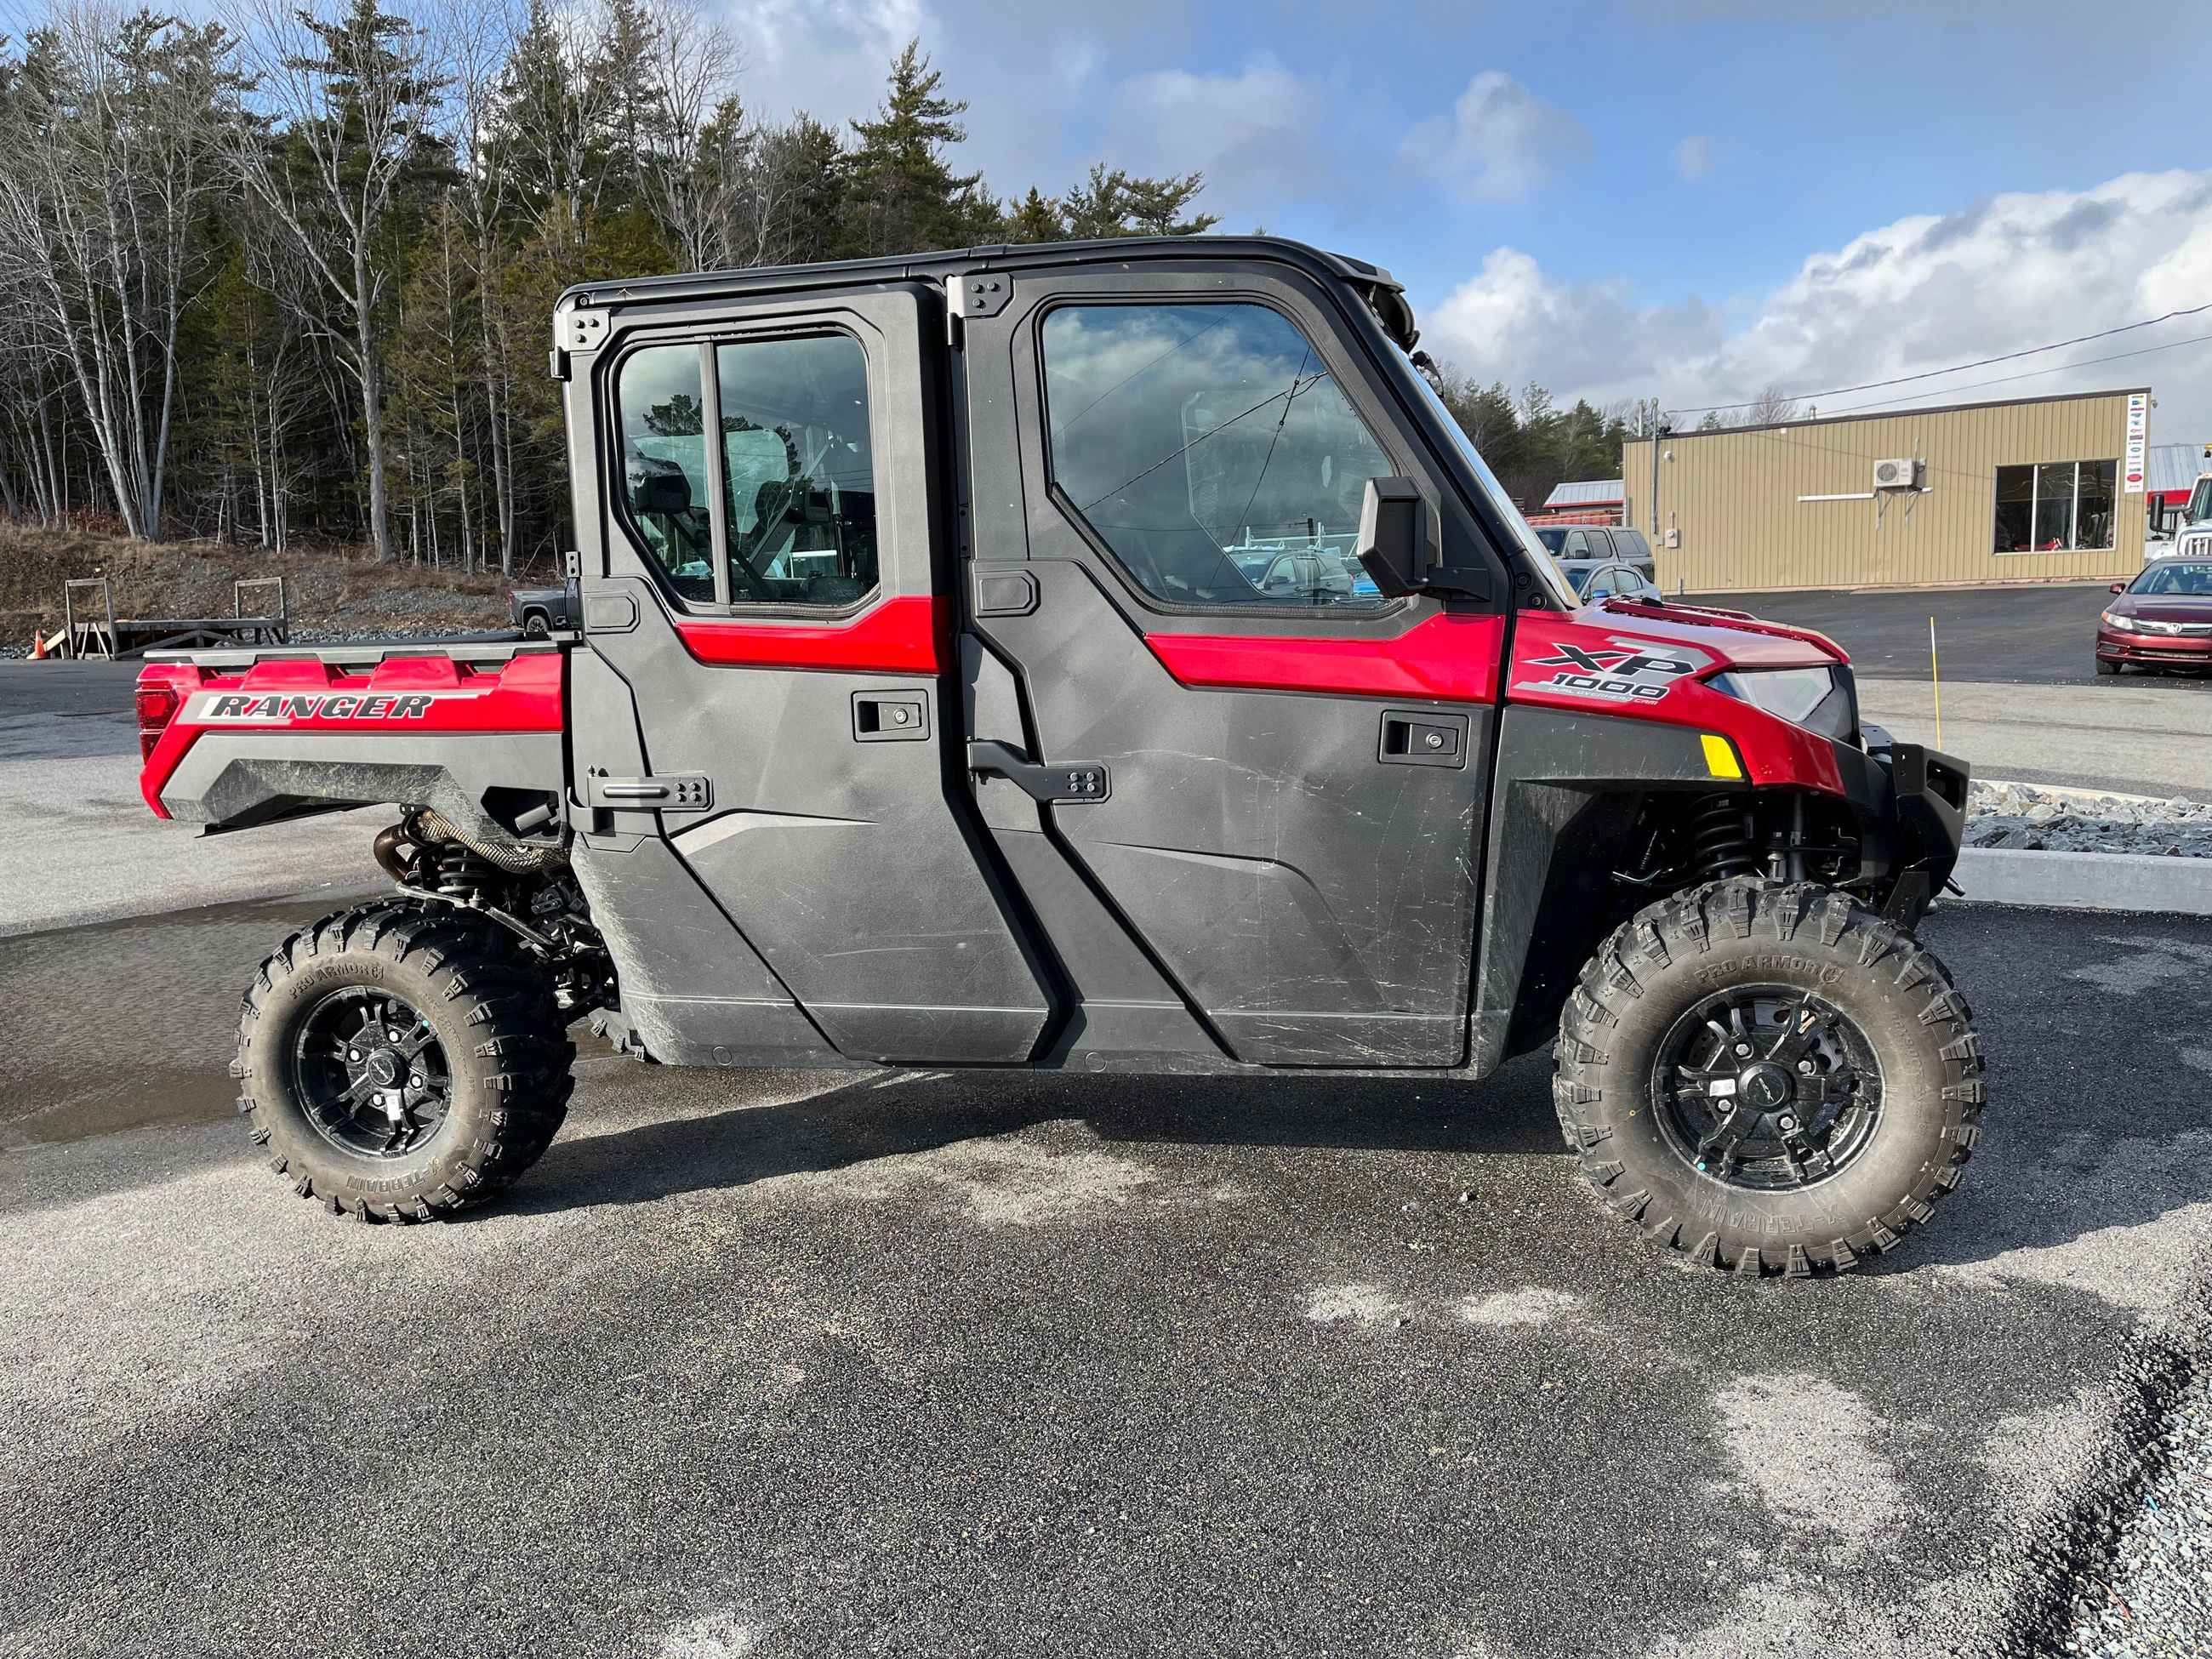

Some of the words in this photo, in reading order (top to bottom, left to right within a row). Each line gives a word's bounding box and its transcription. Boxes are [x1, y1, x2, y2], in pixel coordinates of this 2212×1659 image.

[1521, 642, 1697, 676] XP
[1552, 671, 1670, 699] 1000
[210, 693, 433, 719] RANGER
[1633, 698, 1658, 706] CAM
[289, 975, 315, 999] PRO
[316, 962, 369, 982] ARMOR
[1694, 959, 1737, 984] PRO
[1741, 955, 1822, 977] ARMOR
